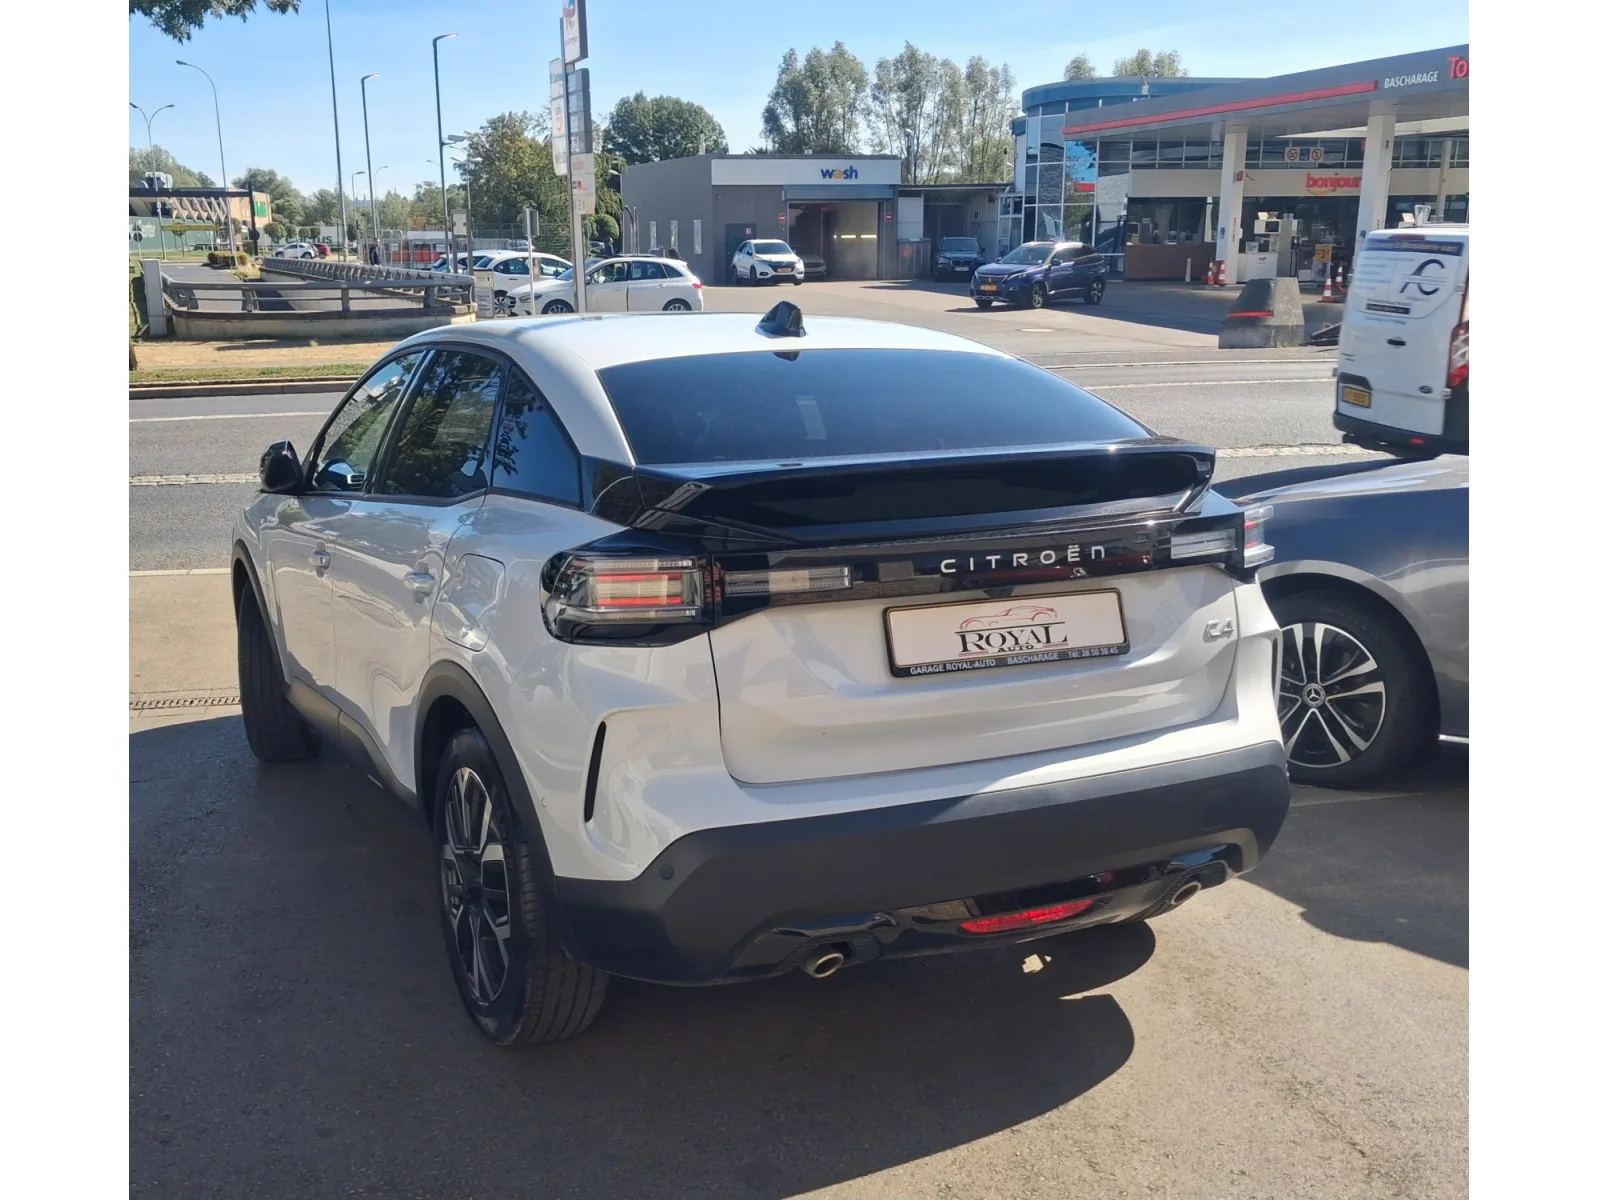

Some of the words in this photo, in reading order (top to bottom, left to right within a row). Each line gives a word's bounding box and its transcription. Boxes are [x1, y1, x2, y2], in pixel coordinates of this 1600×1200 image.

[1384, 71, 1439, 88] BASCHARAGE
[820, 165, 858, 180] wash
[1305, 172, 1363, 192] bonjour
[959, 626, 1067, 653] ROYAL
[1203, 618, 1233, 643] C4
[998, 644, 1034, 653] AUTO
[910, 664, 945, 675] GARAGE
[946, 659, 996, 671] ROYAL-AUTO
[1007, 652, 1060, 664] BASCHARAGE
